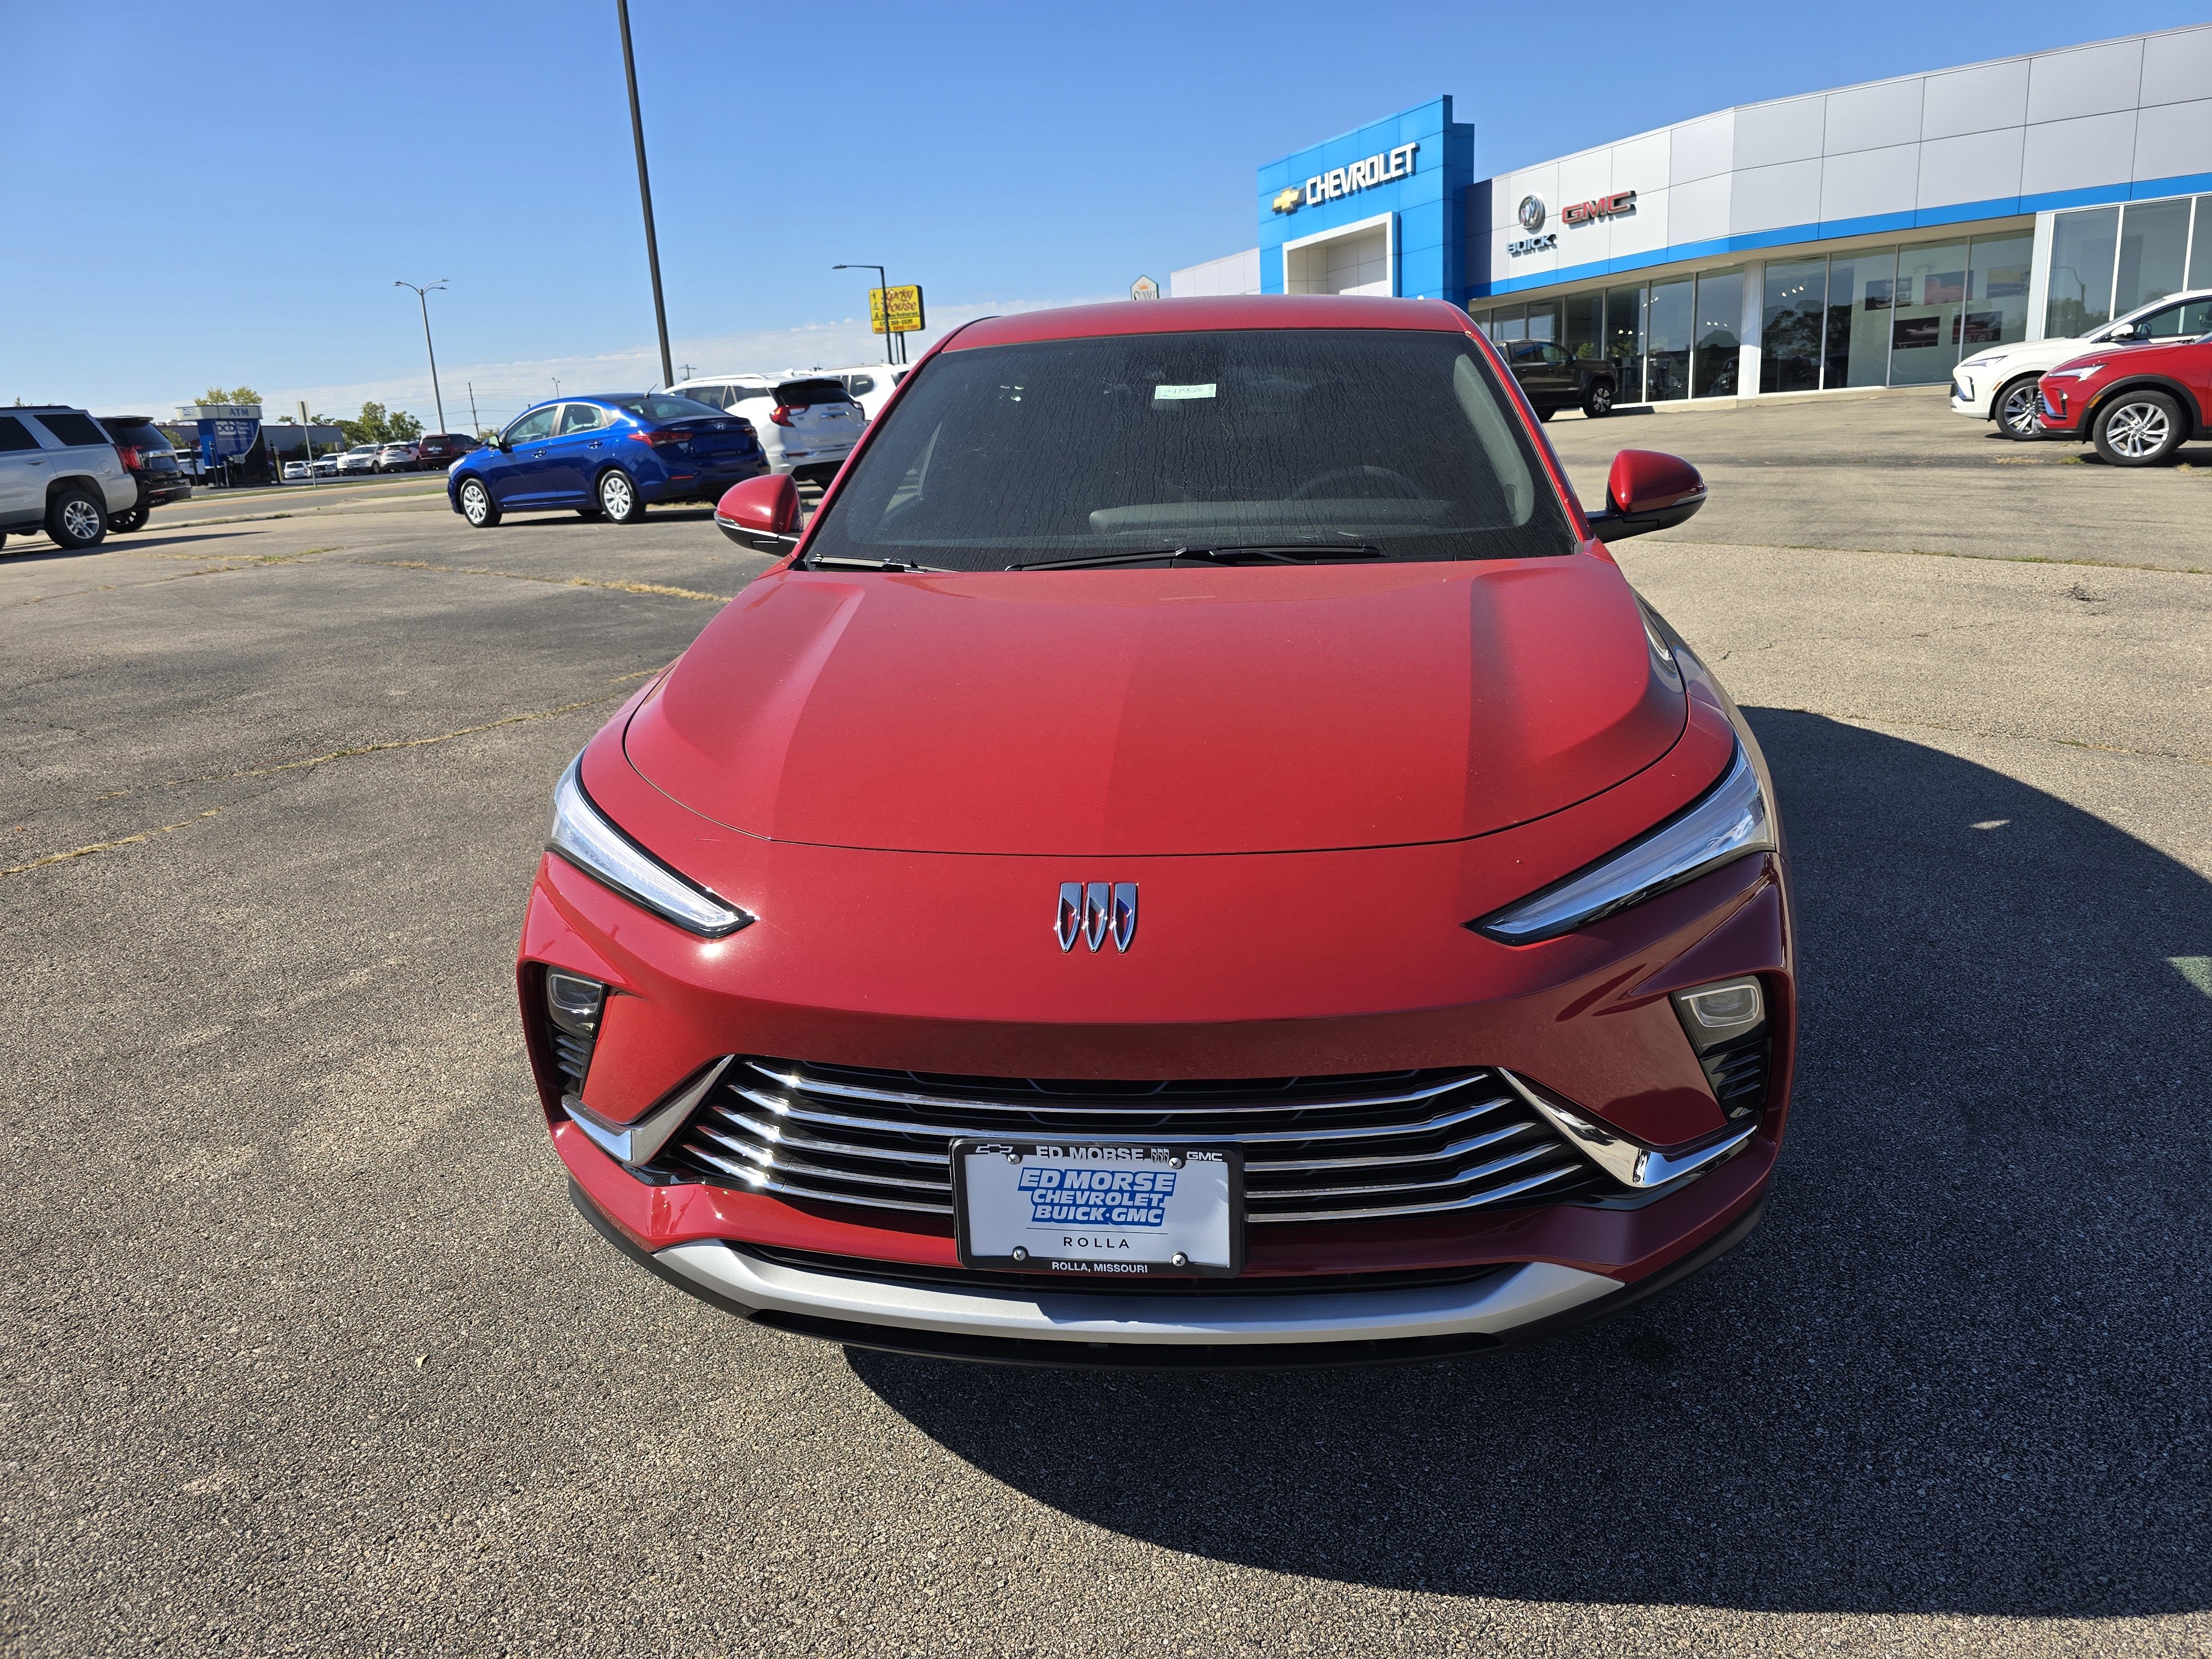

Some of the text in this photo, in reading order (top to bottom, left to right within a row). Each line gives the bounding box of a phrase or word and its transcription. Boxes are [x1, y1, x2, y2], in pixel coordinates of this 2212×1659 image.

[1306, 142, 1419, 205] CHEVROLET
[1562, 190, 1636, 224] GMC
[1506, 234, 1555, 254] BUICK
[229, 408, 249, 416] ATM
[1036, 1145, 1144, 1161] ED MORSE
[1186, 1151, 1223, 1162] GMC
[1019, 1168, 1176, 1192] ED MORSE
[1032, 1189, 1164, 1207] CHEVROLET
[1063, 1236, 1130, 1249] ROLLA
[1051, 1261, 1149, 1273] ROLLA, MISSOURI
